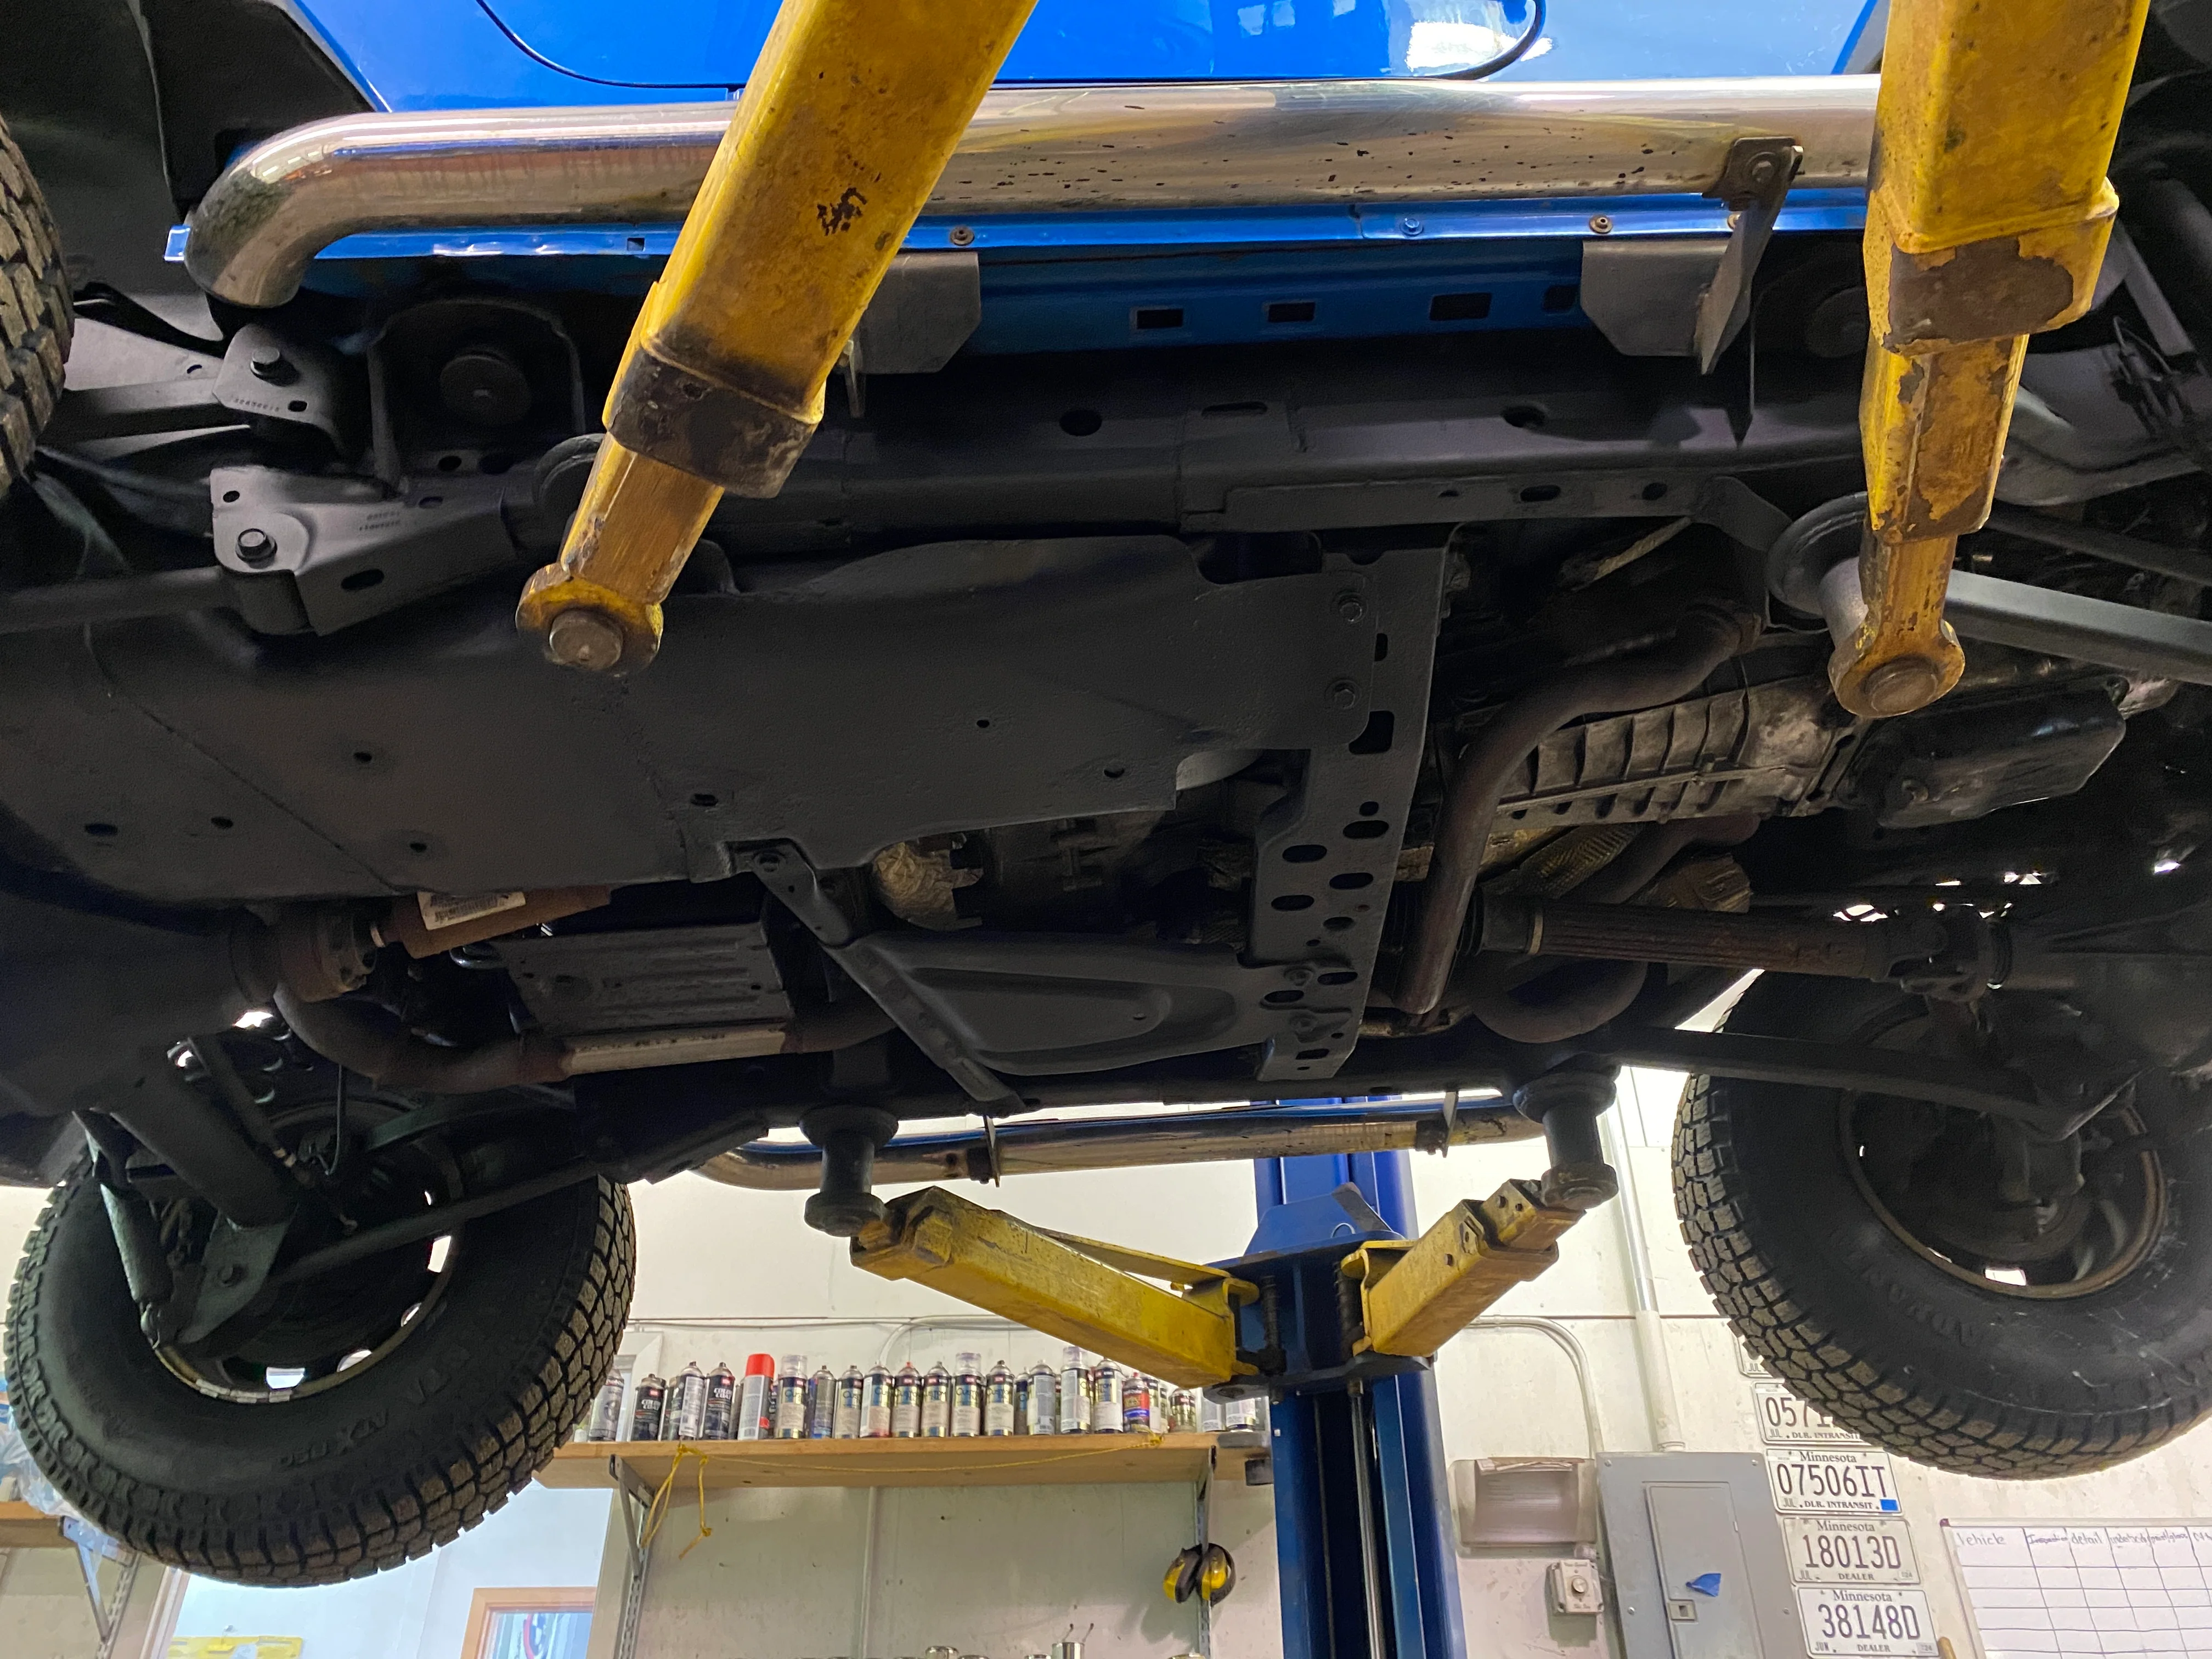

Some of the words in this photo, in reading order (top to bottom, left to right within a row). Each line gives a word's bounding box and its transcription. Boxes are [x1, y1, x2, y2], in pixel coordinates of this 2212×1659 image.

[1799, 1451, 1857, 1463] Minnesota
[1777, 1463, 1887, 1498] 07506IT
[1827, 1501, 1873, 1509] INTRANSIT
[1816, 1520, 1876, 1532] Minnesota
[1803, 1534, 1901, 1569] 18013D
[1838, 1572, 1875, 1581] DEALER
[1833, 1590, 1892, 1602] Minnesota
[1818, 1604, 1921, 1640] 38148D
[1857, 1644, 1891, 1652] DEALER
